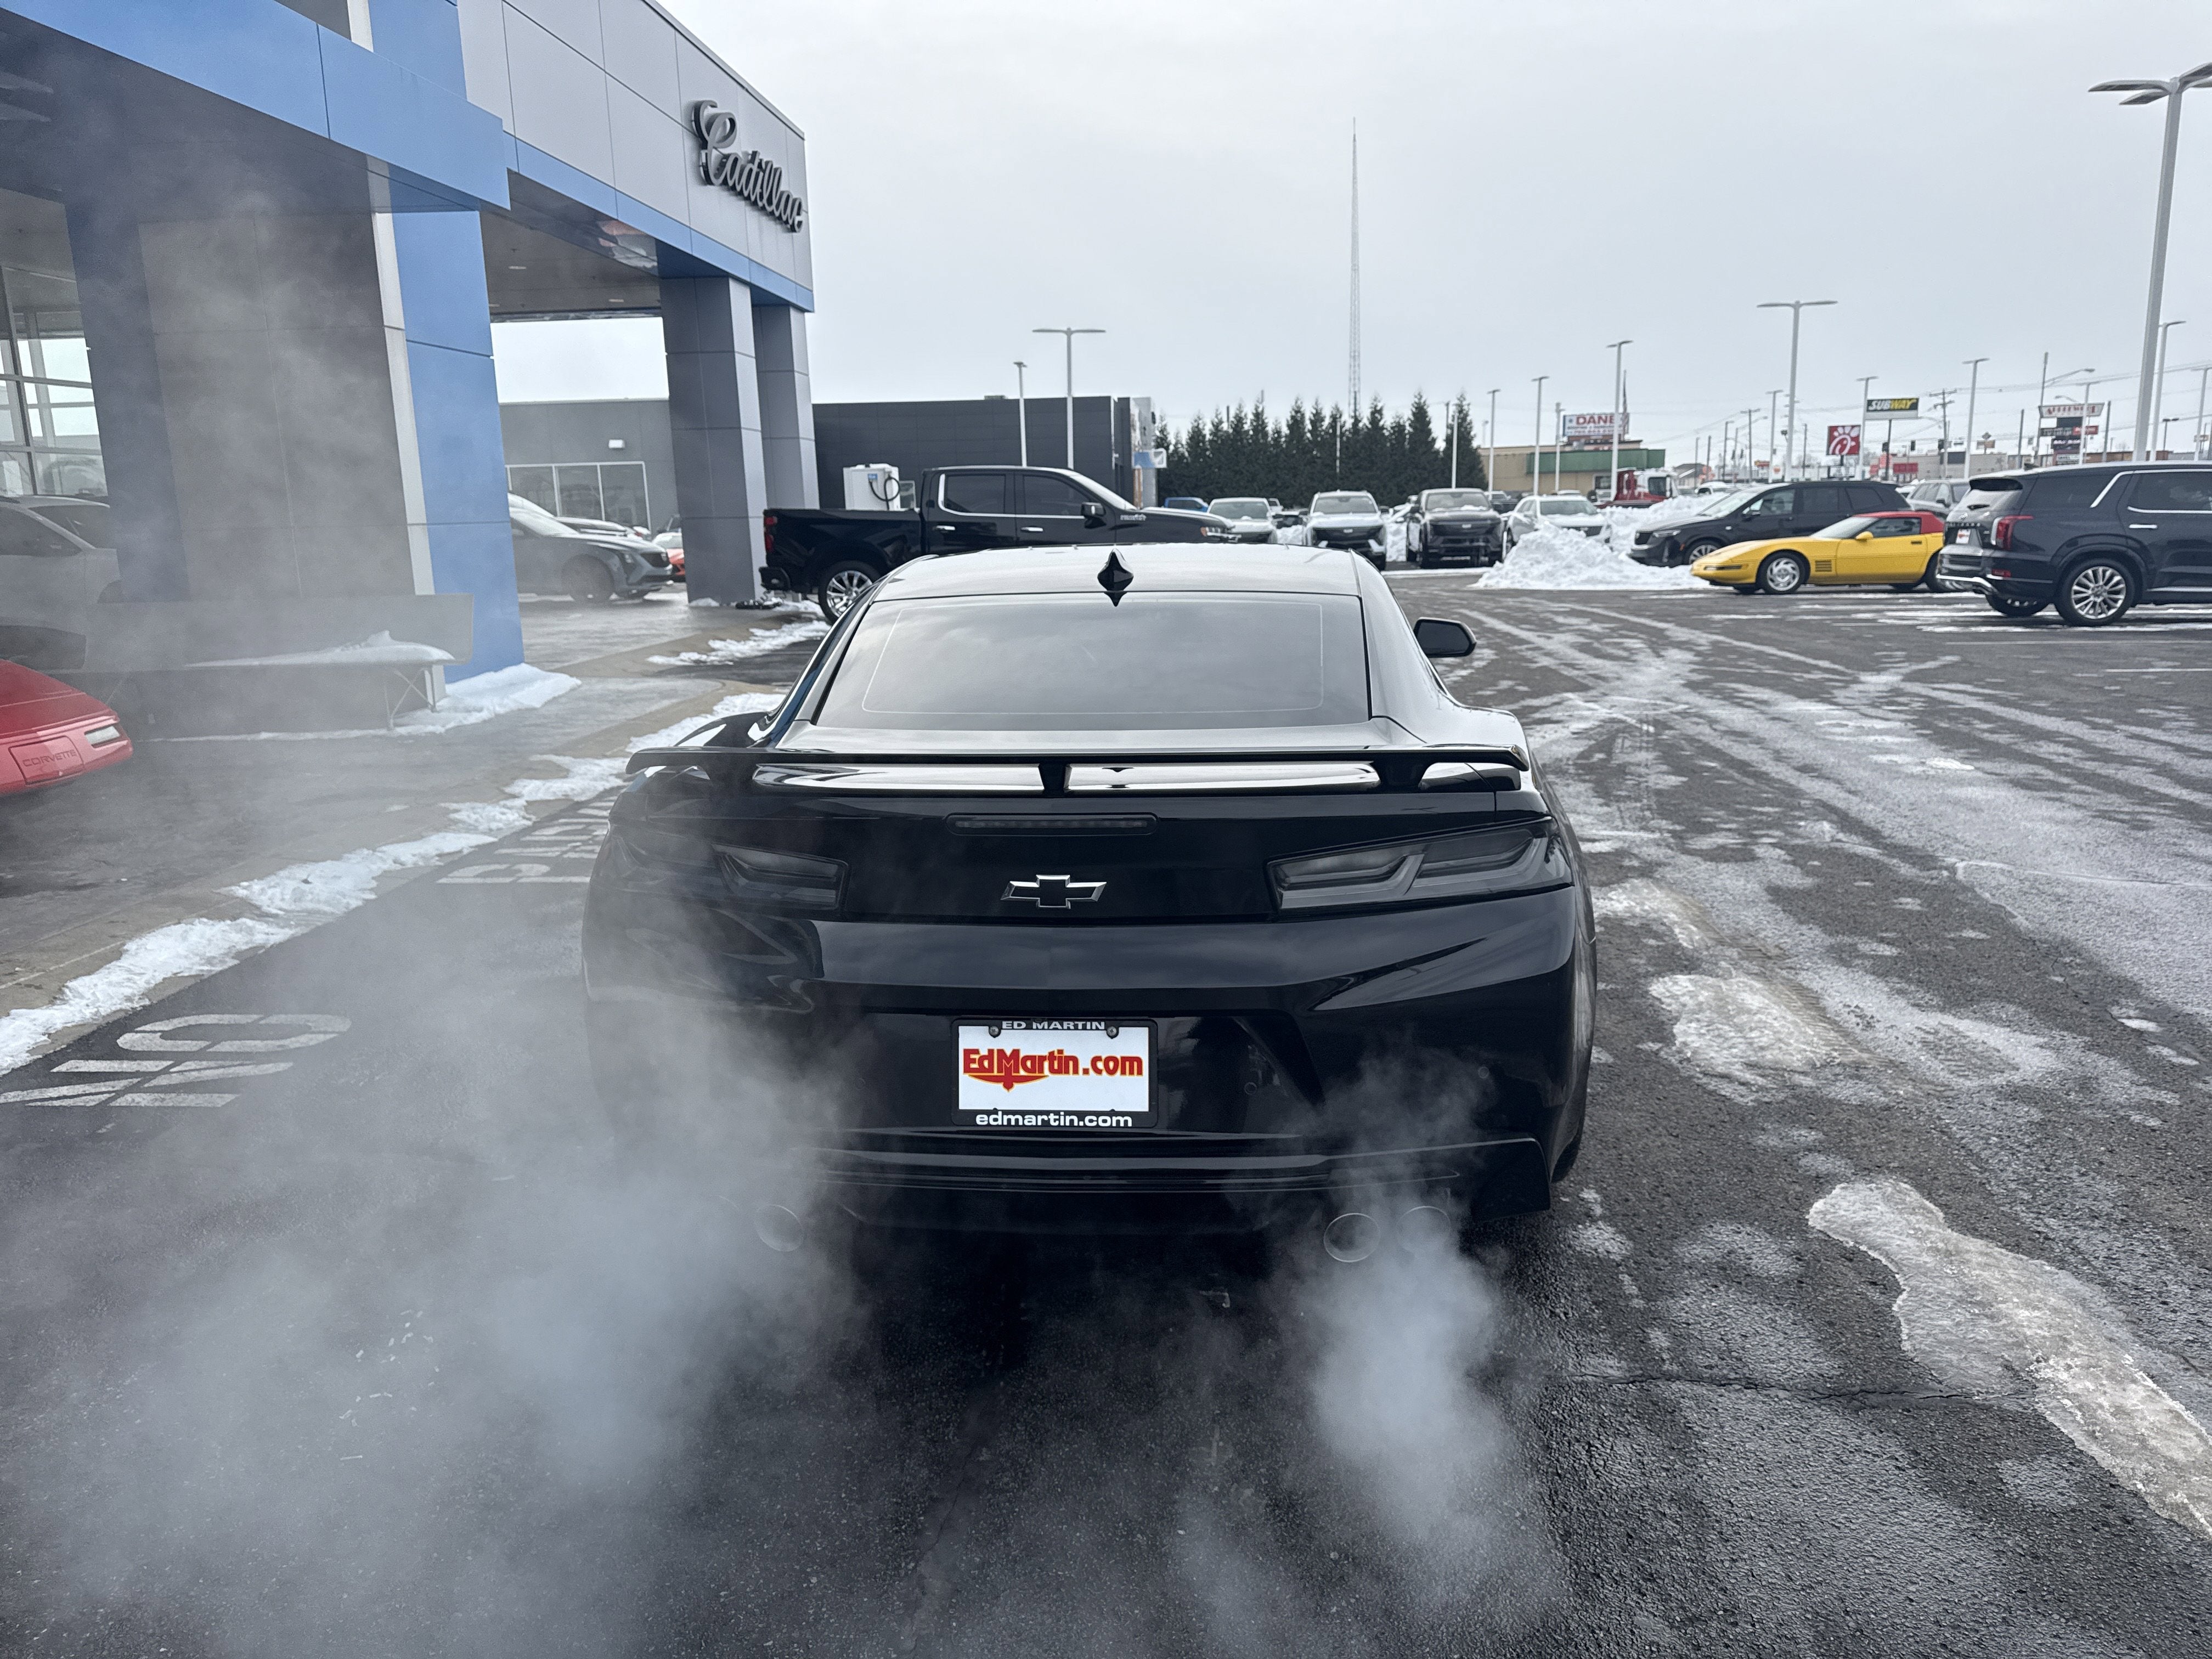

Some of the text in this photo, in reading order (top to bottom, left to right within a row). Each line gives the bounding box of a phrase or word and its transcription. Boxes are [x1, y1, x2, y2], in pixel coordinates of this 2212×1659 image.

[692, 100, 803, 233] Cadillac
[1869, 398, 1916, 411] SUBWAY
[22, 749, 76, 766] CORVETTE
[1002, 1020, 1105, 1030] ED MARTIN
[962, 1048, 1143, 1084] EdMartin.com
[975, 1111, 1132, 1127] edmartin.com
